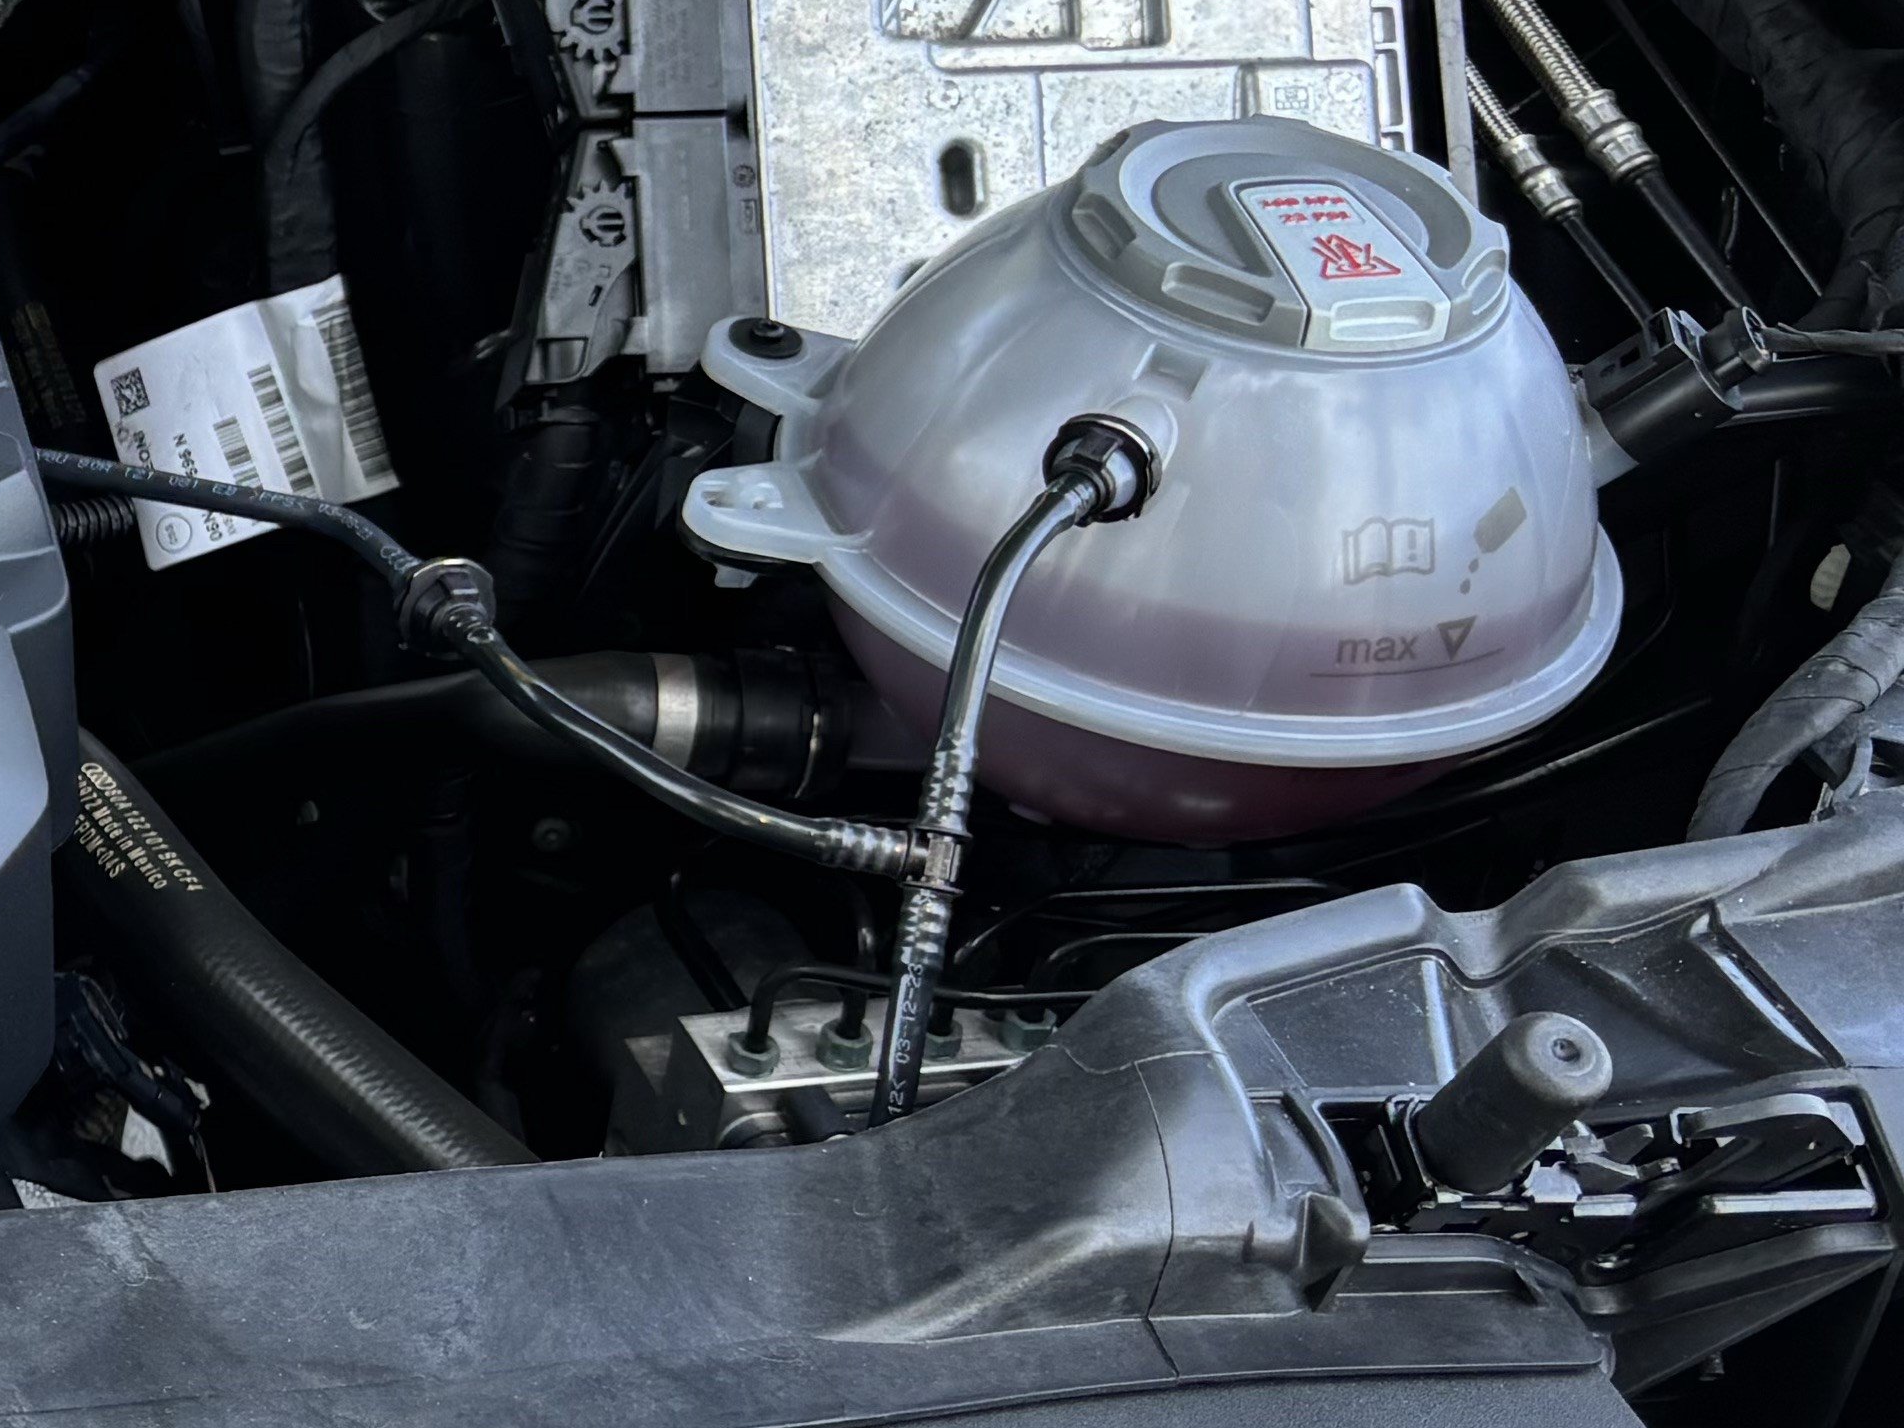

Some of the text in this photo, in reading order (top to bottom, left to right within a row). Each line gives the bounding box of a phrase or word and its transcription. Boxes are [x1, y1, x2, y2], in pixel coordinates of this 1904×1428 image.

[1335, 634, 1418, 665] max
[91, 805, 169, 891] Made in Mexico
